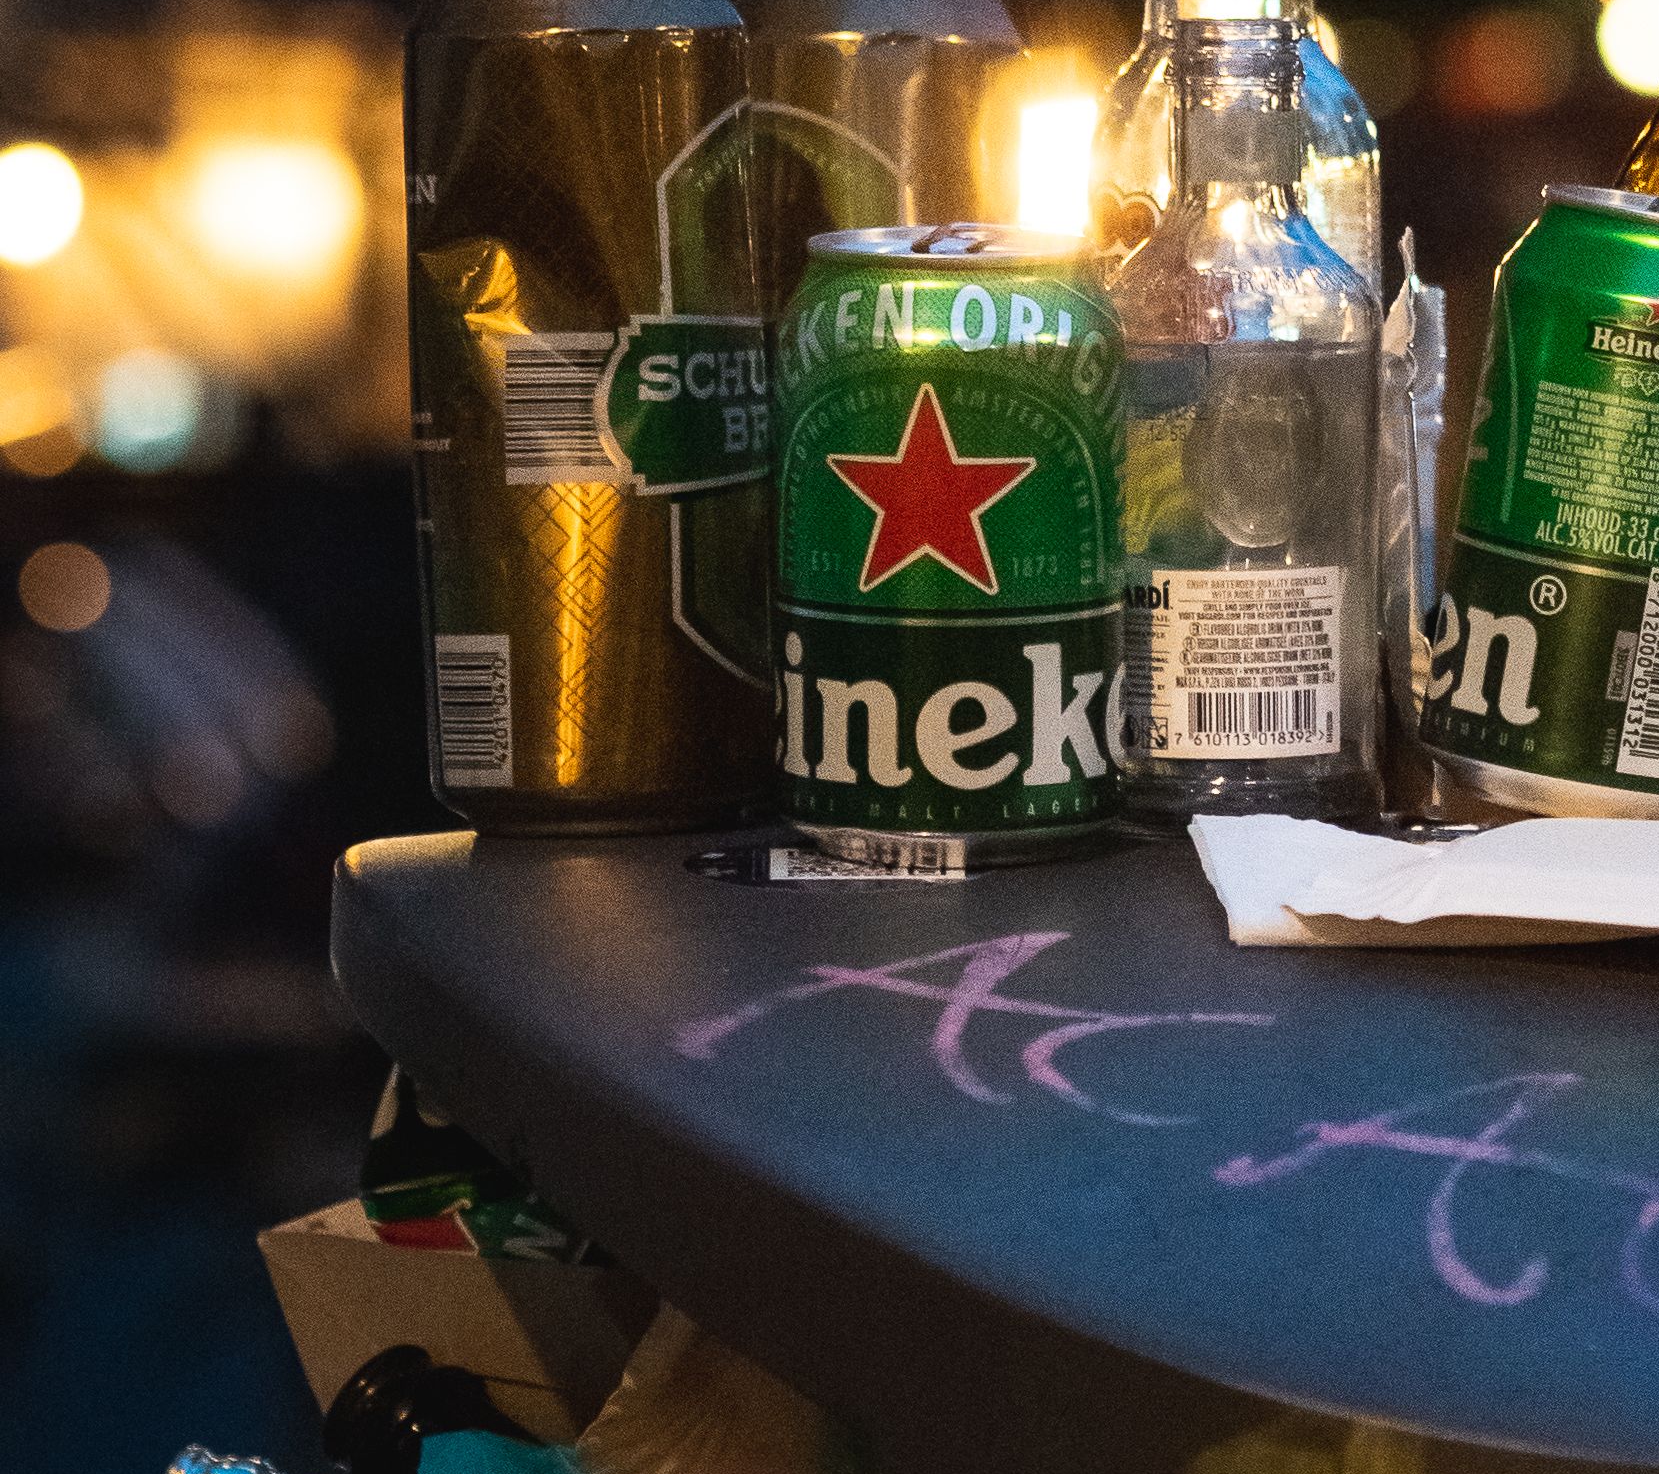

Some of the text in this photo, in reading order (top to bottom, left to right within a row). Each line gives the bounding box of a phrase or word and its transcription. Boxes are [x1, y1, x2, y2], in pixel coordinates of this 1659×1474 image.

[1556, 502, 1627, 536] INHOUD:
[1626, 515, 1649, 540] 33
[1622, 676, 1649, 750] 031312
